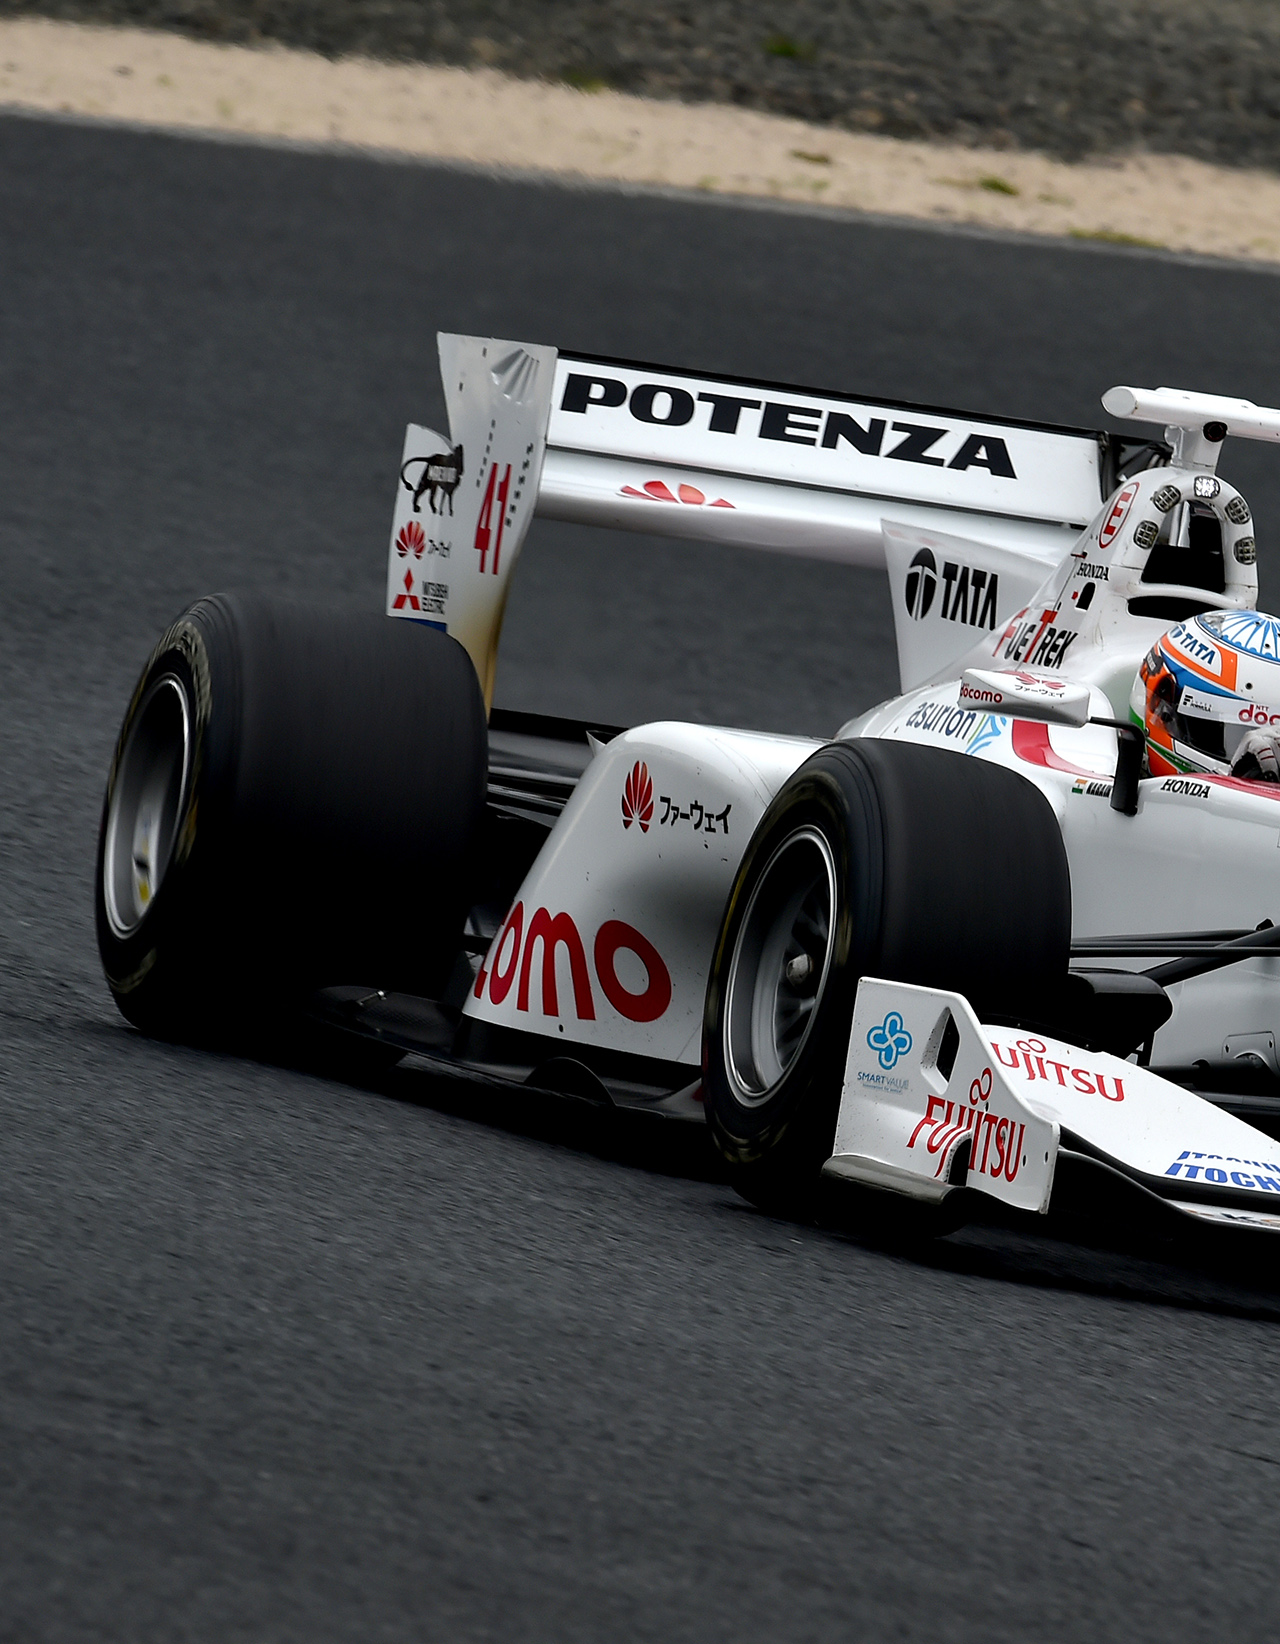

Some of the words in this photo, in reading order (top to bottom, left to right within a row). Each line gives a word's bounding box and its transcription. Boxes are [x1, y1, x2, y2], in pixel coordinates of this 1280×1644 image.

[560, 373, 1018, 480] POTENZA
[474, 462, 512, 575] 41
[940, 561, 999, 631] TATA
[1076, 562, 1110, 582] HONDA
[1179, 632, 1216, 665] TATA
[905, 702, 977, 740] asurion
[659, 795, 732, 834] ファーウェイ
[1161, 779, 1211, 798] HONDA
[473, 900, 672, 1023] omo
[990, 1041, 1125, 1102] UJITSU
[906, 1092, 1027, 1183] FUJITSU
